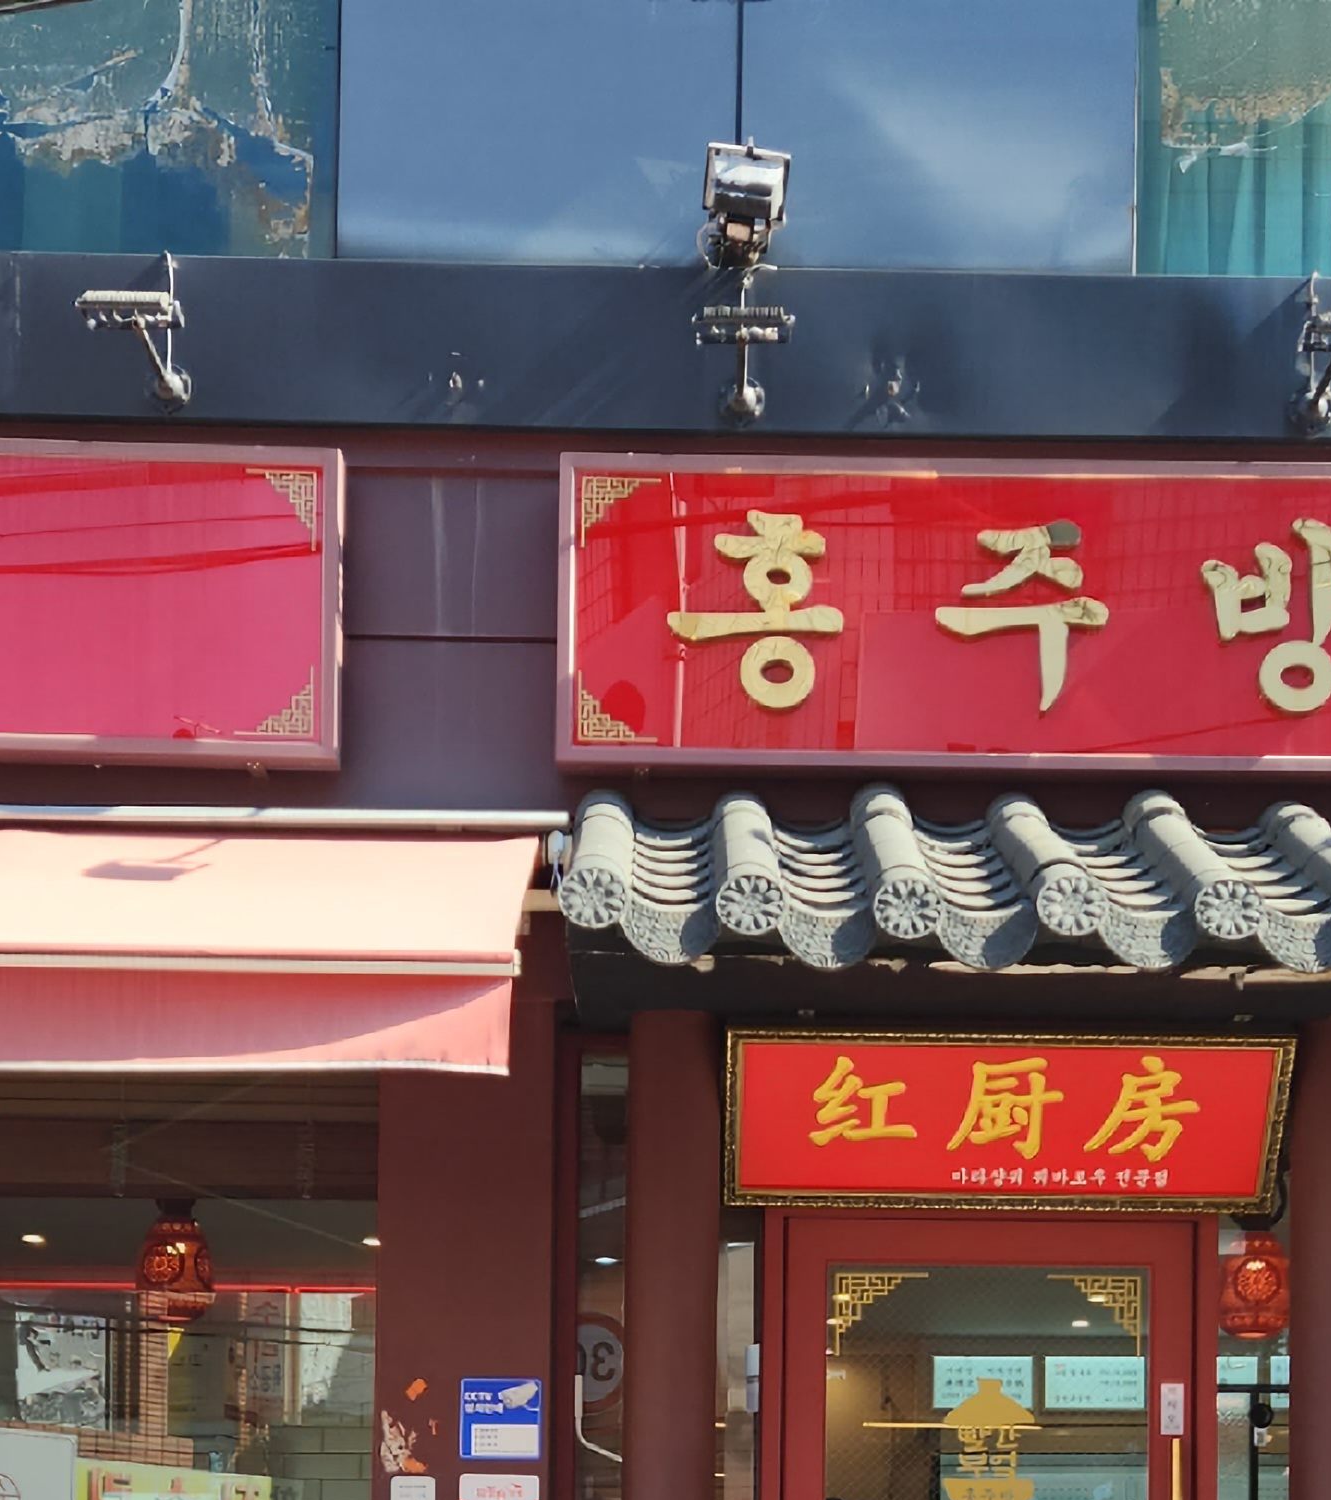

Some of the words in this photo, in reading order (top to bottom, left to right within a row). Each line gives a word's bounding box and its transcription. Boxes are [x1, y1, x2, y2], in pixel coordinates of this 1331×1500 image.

[808, 1055, 1202, 1162] 红厨房
[958, 1426, 1019, 1452] 빨간
